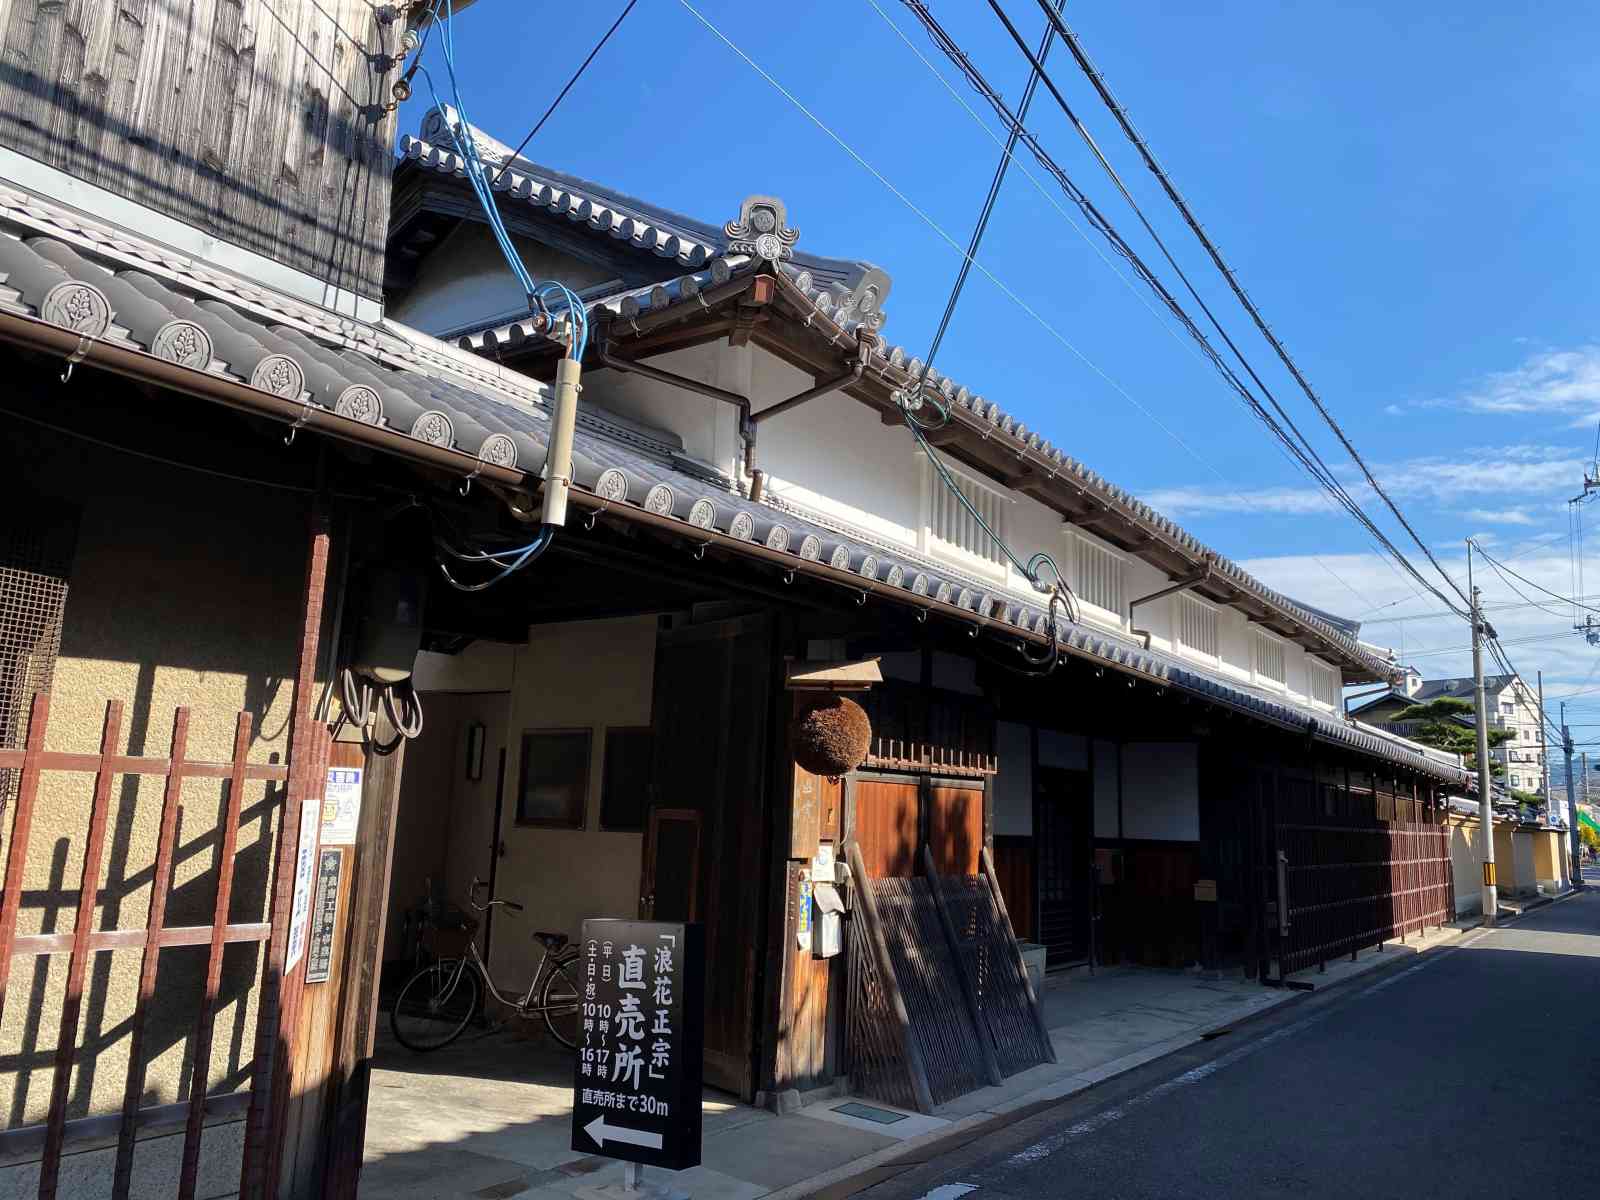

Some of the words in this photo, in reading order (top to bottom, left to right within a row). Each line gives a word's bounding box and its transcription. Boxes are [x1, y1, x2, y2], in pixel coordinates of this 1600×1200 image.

[611, 944, 647, 1090] 直売所
[649, 934, 675, 1079] 「浪花正宗」
[582, 1088, 669, 1117] 直売所まで30m
